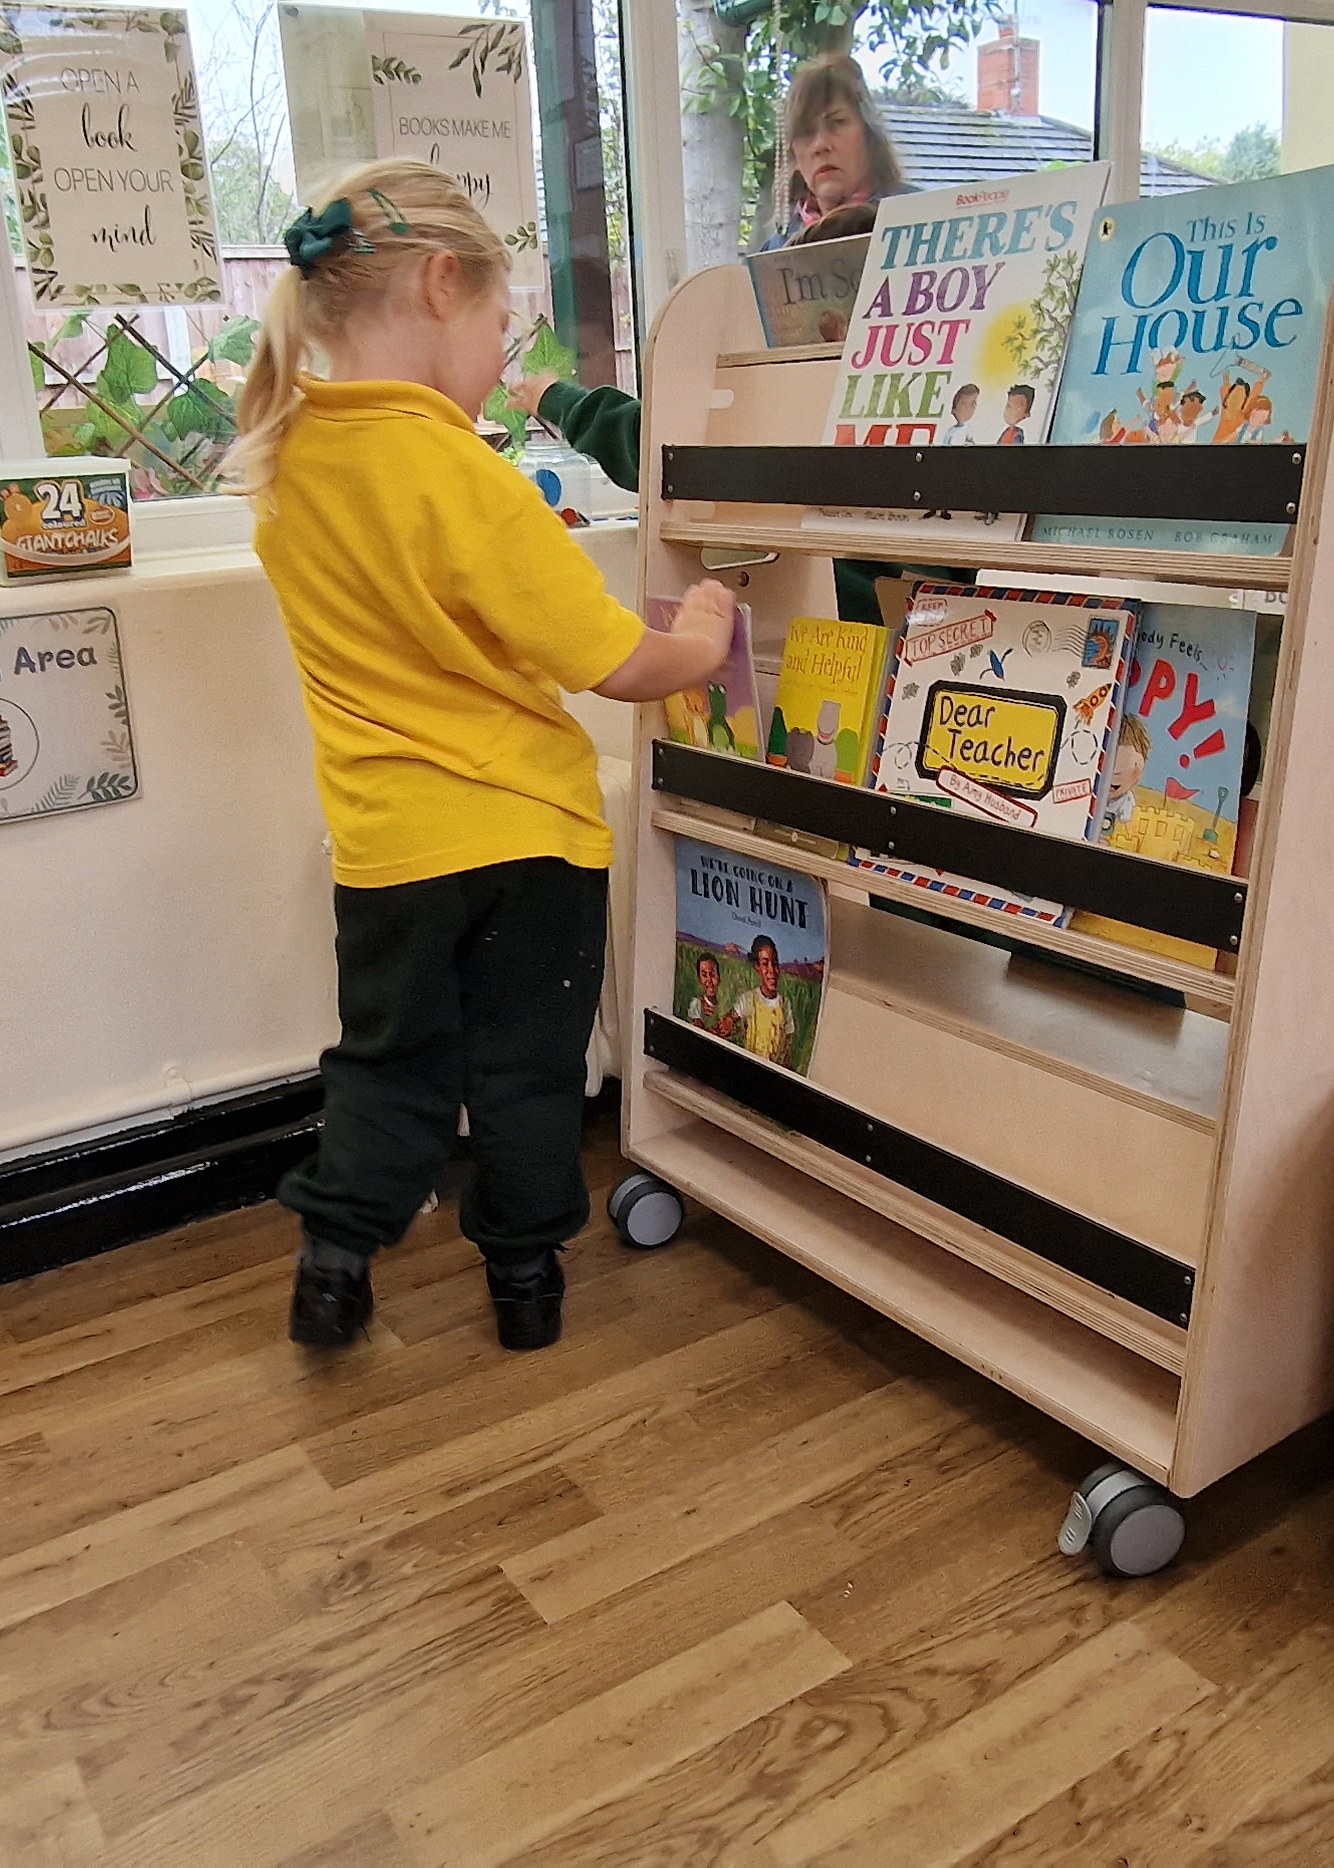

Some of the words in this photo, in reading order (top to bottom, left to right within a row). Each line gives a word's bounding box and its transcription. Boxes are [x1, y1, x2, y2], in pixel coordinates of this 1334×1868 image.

[60, 67, 122, 94] OPEN
[126, 70, 141, 94] A
[81, 102, 138, 152] book
[398, 116, 450, 137] BOOKS
[451, 119, 490, 139] MAKE
[492, 120, 512, 139] ME
[53, 166, 115, 193] OPEN
[116, 168, 175, 194] YOUR
[91, 203, 157, 253] mind
[880, 200, 1078, 271] THERE'S
[1187, 216, 1237, 243] This
[1245, 211, 1267, 236] Is
[777, 266, 828, 306] I'm
[861, 274, 895, 320] A
[901, 261, 1006, 317] BOY
[1121, 231, 1279, 310] Our
[850, 318, 972, 370] JUST
[1089, 297, 1305, 377] House
[838, 370, 953, 420] LIKE
[37, 481, 83, 520] 24
[1107, 526, 1156, 541] ROSEN
[1174, 529, 1203, 543] BOB
[835, 624, 869, 655] Kind
[911, 635, 936, 657] TOP
[937, 617, 991, 650] SECRET
[13, 645, 99, 676] Area
[785, 648, 809, 676] and
[810, 652, 864, 686] Helpful
[939, 695, 997, 729] Dear
[947, 727, 1045, 773] Teacher
[949, 773, 962, 791] By
[962, 781, 983, 803] Amy
[983, 792, 1023, 821] Husband
[689, 867, 740, 909] LION
[748, 885, 809, 930] HUNT
